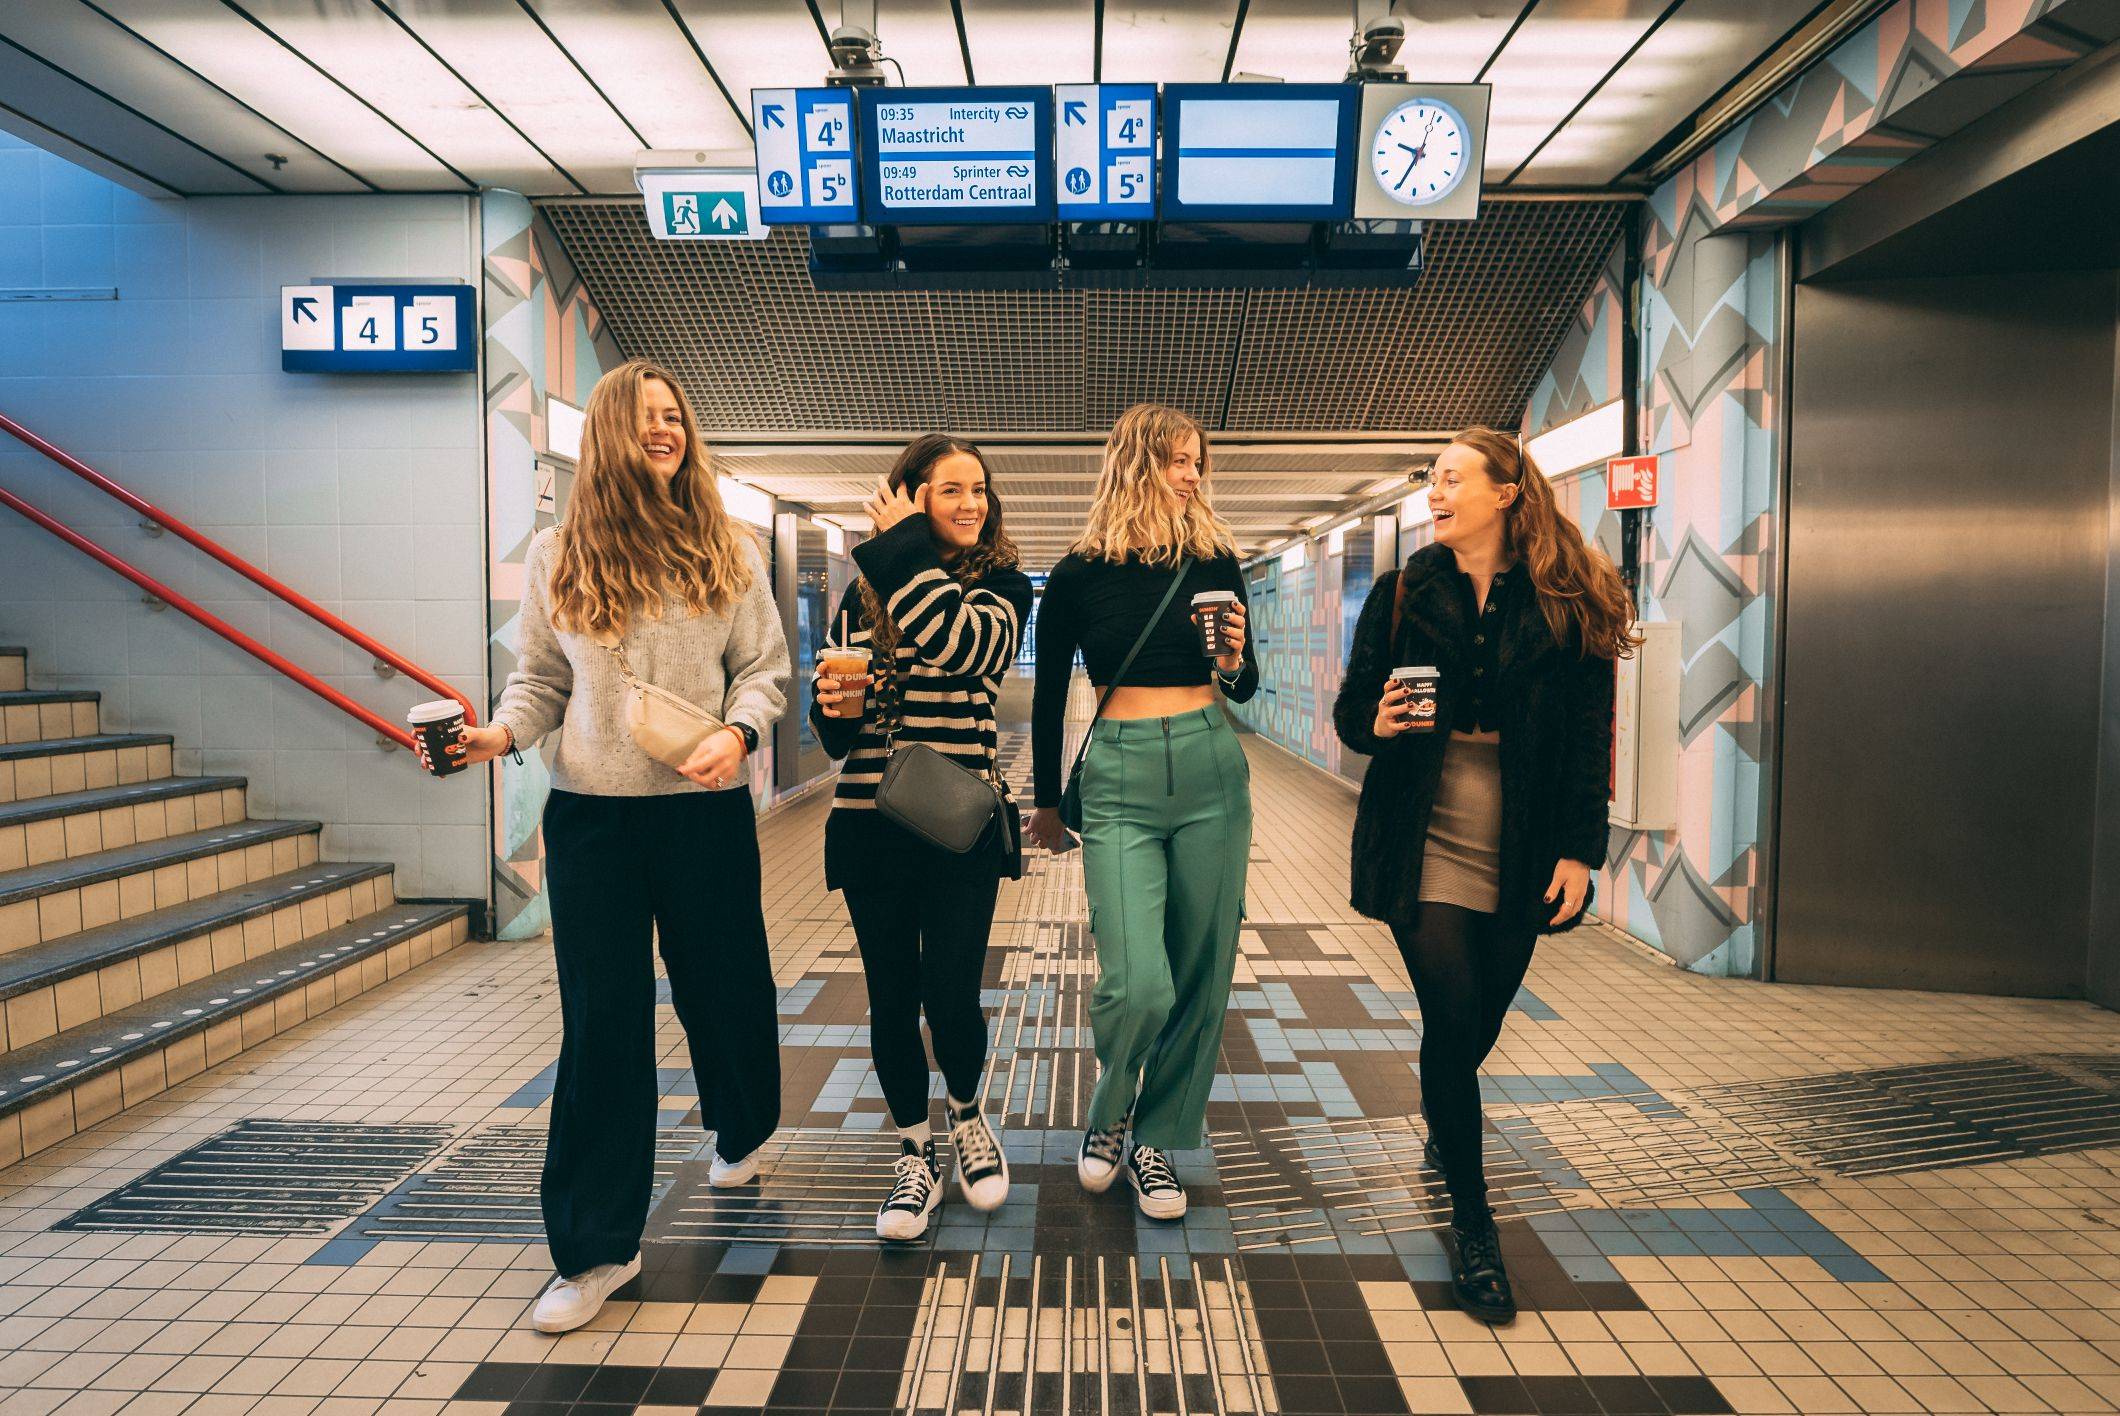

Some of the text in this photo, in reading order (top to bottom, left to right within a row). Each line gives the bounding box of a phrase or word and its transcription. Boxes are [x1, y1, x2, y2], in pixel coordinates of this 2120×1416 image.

[881, 107, 1000, 123] 09:35 Intercity
[882, 127, 965, 144] Maastricht
[883, 166, 1001, 181] 09:49 Sprinter
[885, 183, 1032, 201] Rotterdam Centraal
[359, 317, 379, 344] 4
[421, 316, 439, 344] 5
